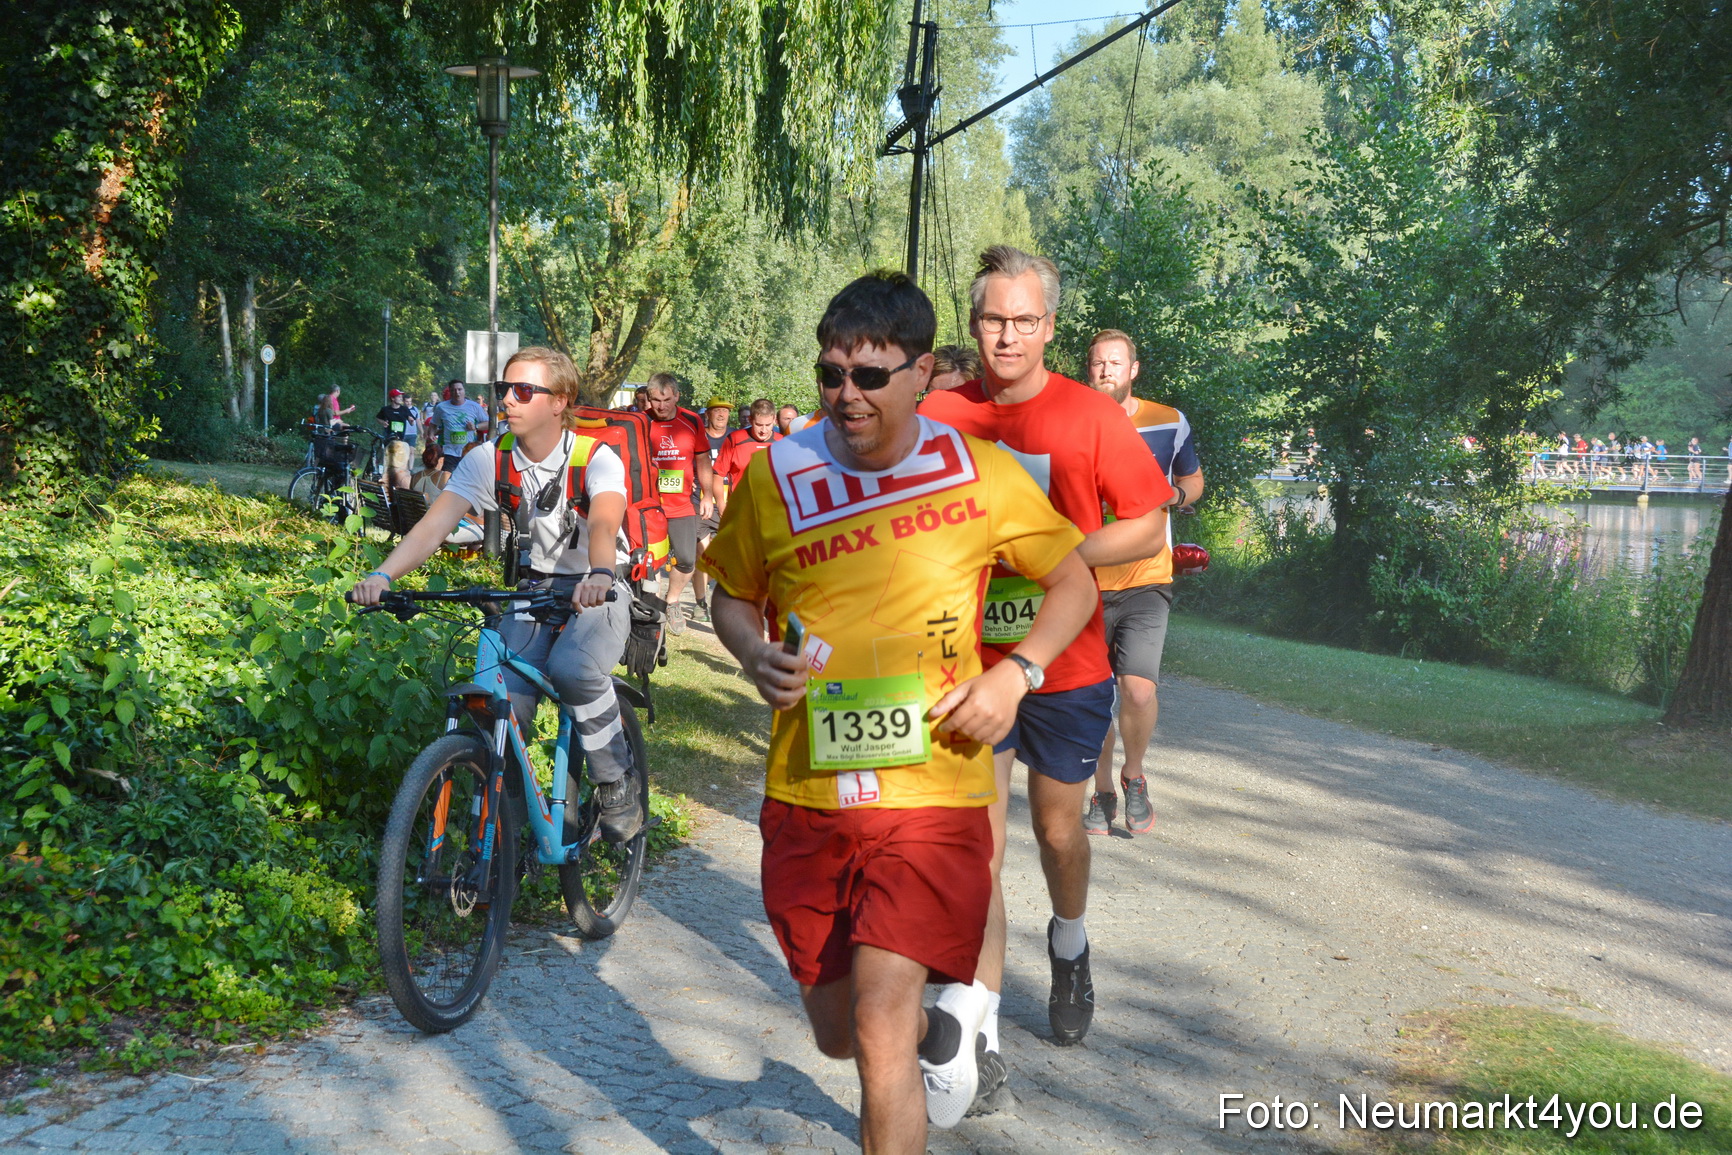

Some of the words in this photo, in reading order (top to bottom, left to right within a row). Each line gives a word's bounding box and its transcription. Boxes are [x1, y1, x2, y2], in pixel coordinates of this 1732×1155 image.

[658, 477, 681, 487] 1359
[794, 524, 880, 570] MAX
[890, 497, 987, 540] BÖGL
[984, 598, 1037, 625] 404
[822, 707, 912, 743] 1339
[840, 753, 855, 761] Bögl
[856, 751, 890, 760] Bauservice
[841, 743, 862, 752] Wulf
[864, 742, 896, 753] Jasper
[482, 823, 495, 860] ROCKSHOX
